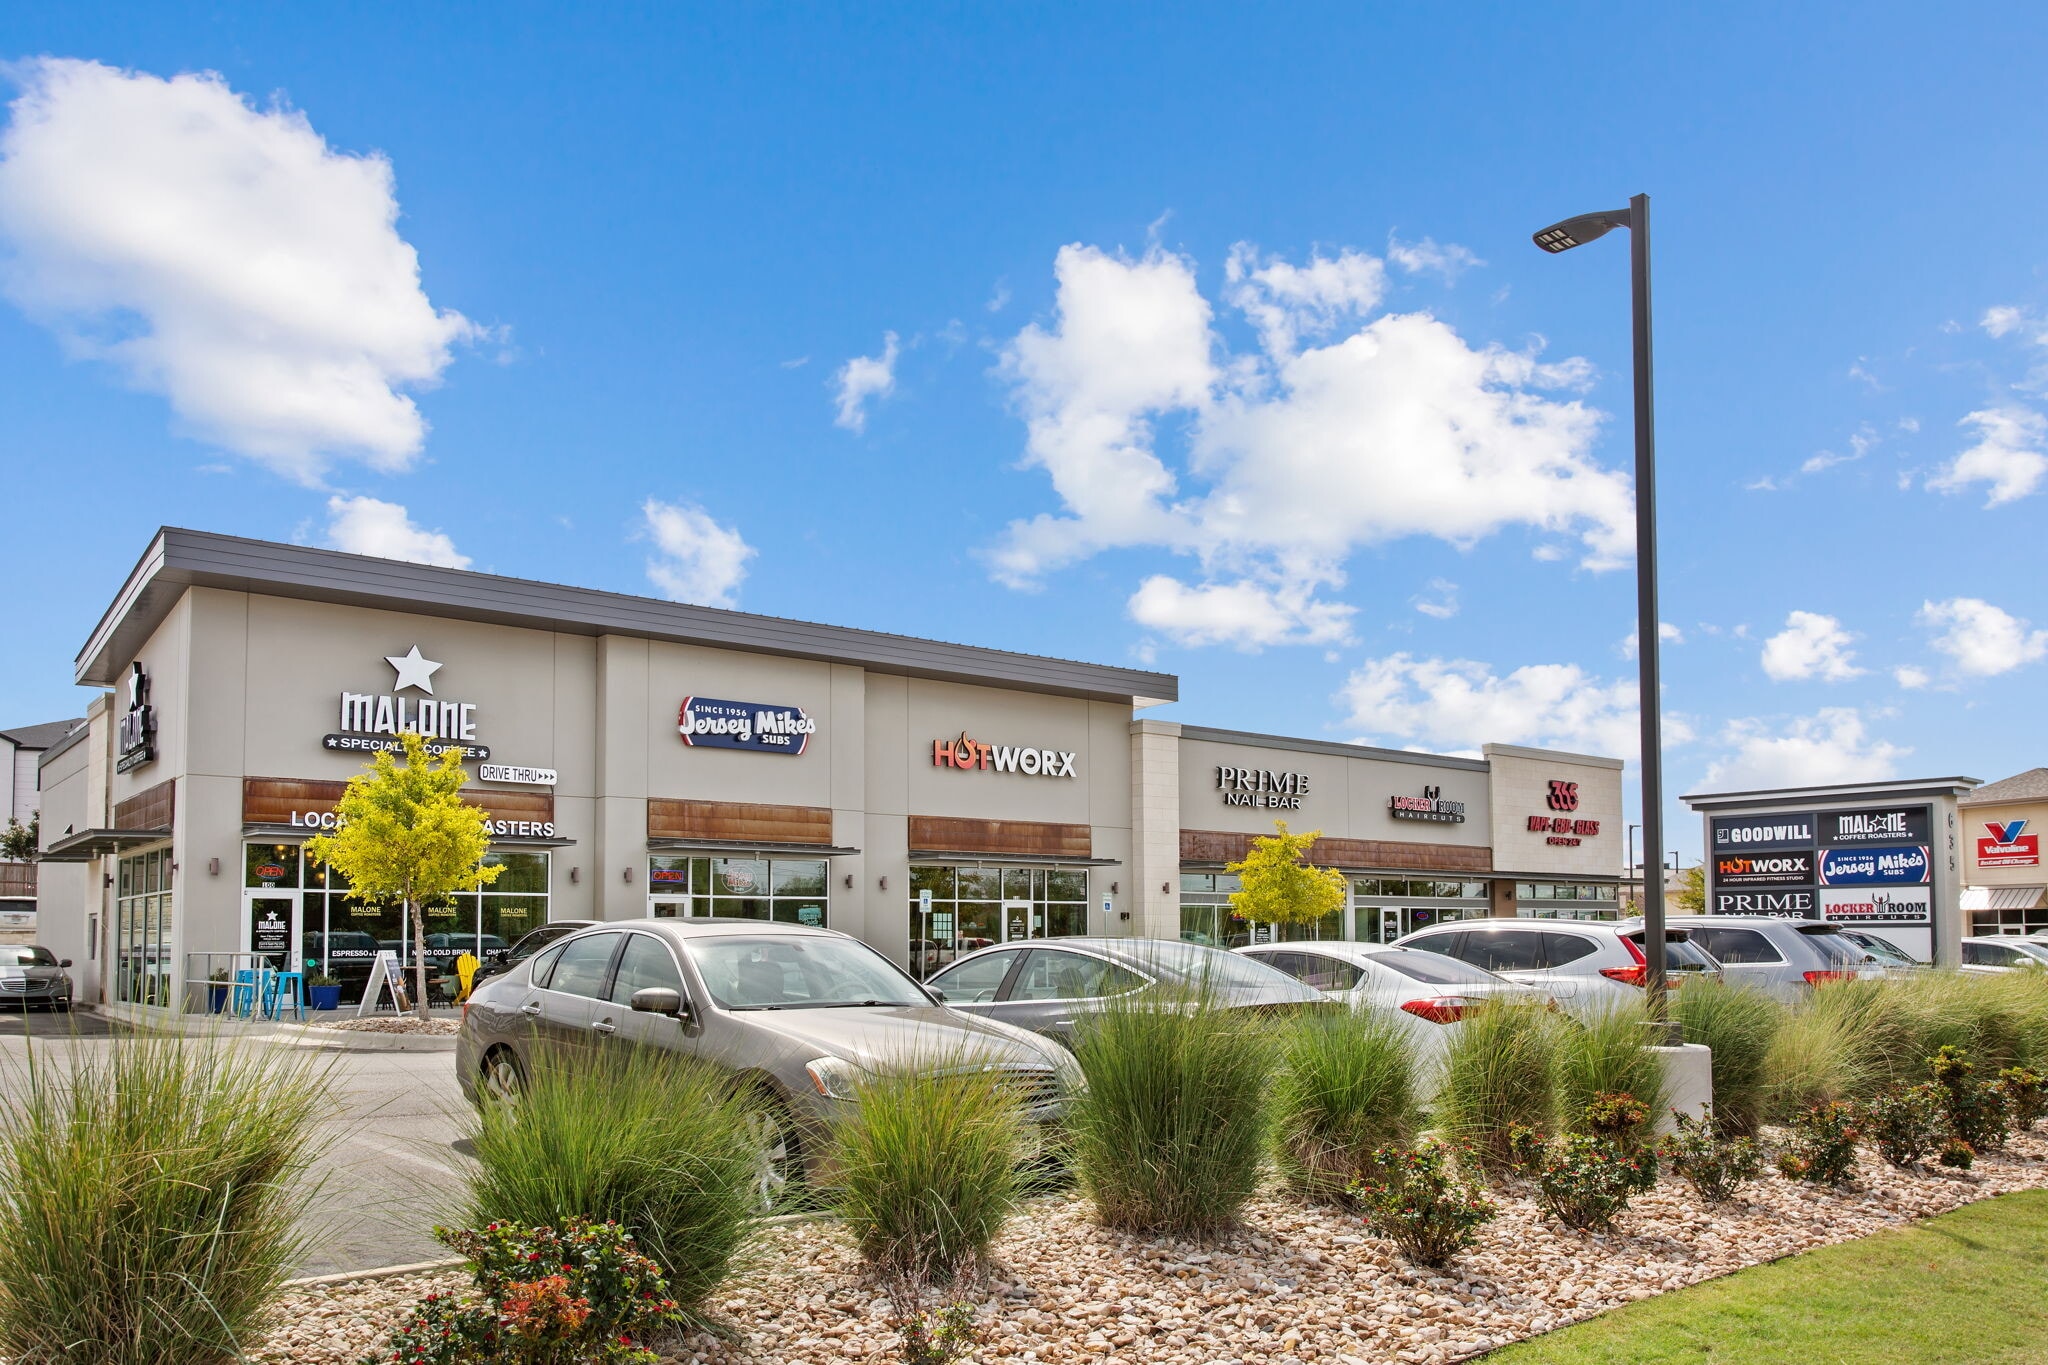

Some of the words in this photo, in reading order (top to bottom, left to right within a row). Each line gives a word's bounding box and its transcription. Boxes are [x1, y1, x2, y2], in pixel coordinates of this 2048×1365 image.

[341, 692, 477, 741] MALONE
[695, 705, 722, 714] SINCE
[726, 708, 747, 717] 1956
[680, 710, 751, 741] Jersey
[755, 711, 816, 735] Mike's
[340, 738, 406, 753] SPECIAL
[762, 734, 791, 745] SUBS
[933, 731, 1077, 777] HOTWORX
[483, 766, 510, 780] DRIVE
[513, 768, 537, 782] THRU
[1217, 766, 1310, 795] PRIME
[1226, 793, 1265, 807] NAIL
[1269, 796, 1301, 809] BAR
[1394, 796, 1431, 811] LOCKER
[1439, 800, 1465, 814] ROOM
[291, 810, 350, 829] LOCA
[483, 819, 554, 837] ASTERS
[1399, 812, 1461, 822] HAIRCUTS
[1731, 824, 1812, 843] GOODWILL
[1867, 831, 1907, 839] ROASTERS
[1984, 844, 2030, 854] Valvoline
[255, 865, 285, 877] OPEN
[1719, 856, 1806, 873] HOTWORX
[1825, 861, 1875, 877] Jersey
[1877, 852, 1924, 870] Mike's
[652, 870, 684, 881] OPEN
[428, 906, 457, 914] MALONE
[1718, 893, 1812, 911] PRIME
[1825, 903, 1875, 914] LOCKER
[1888, 902, 1927, 913] ROOM
[258, 920, 286, 930] MALONE
